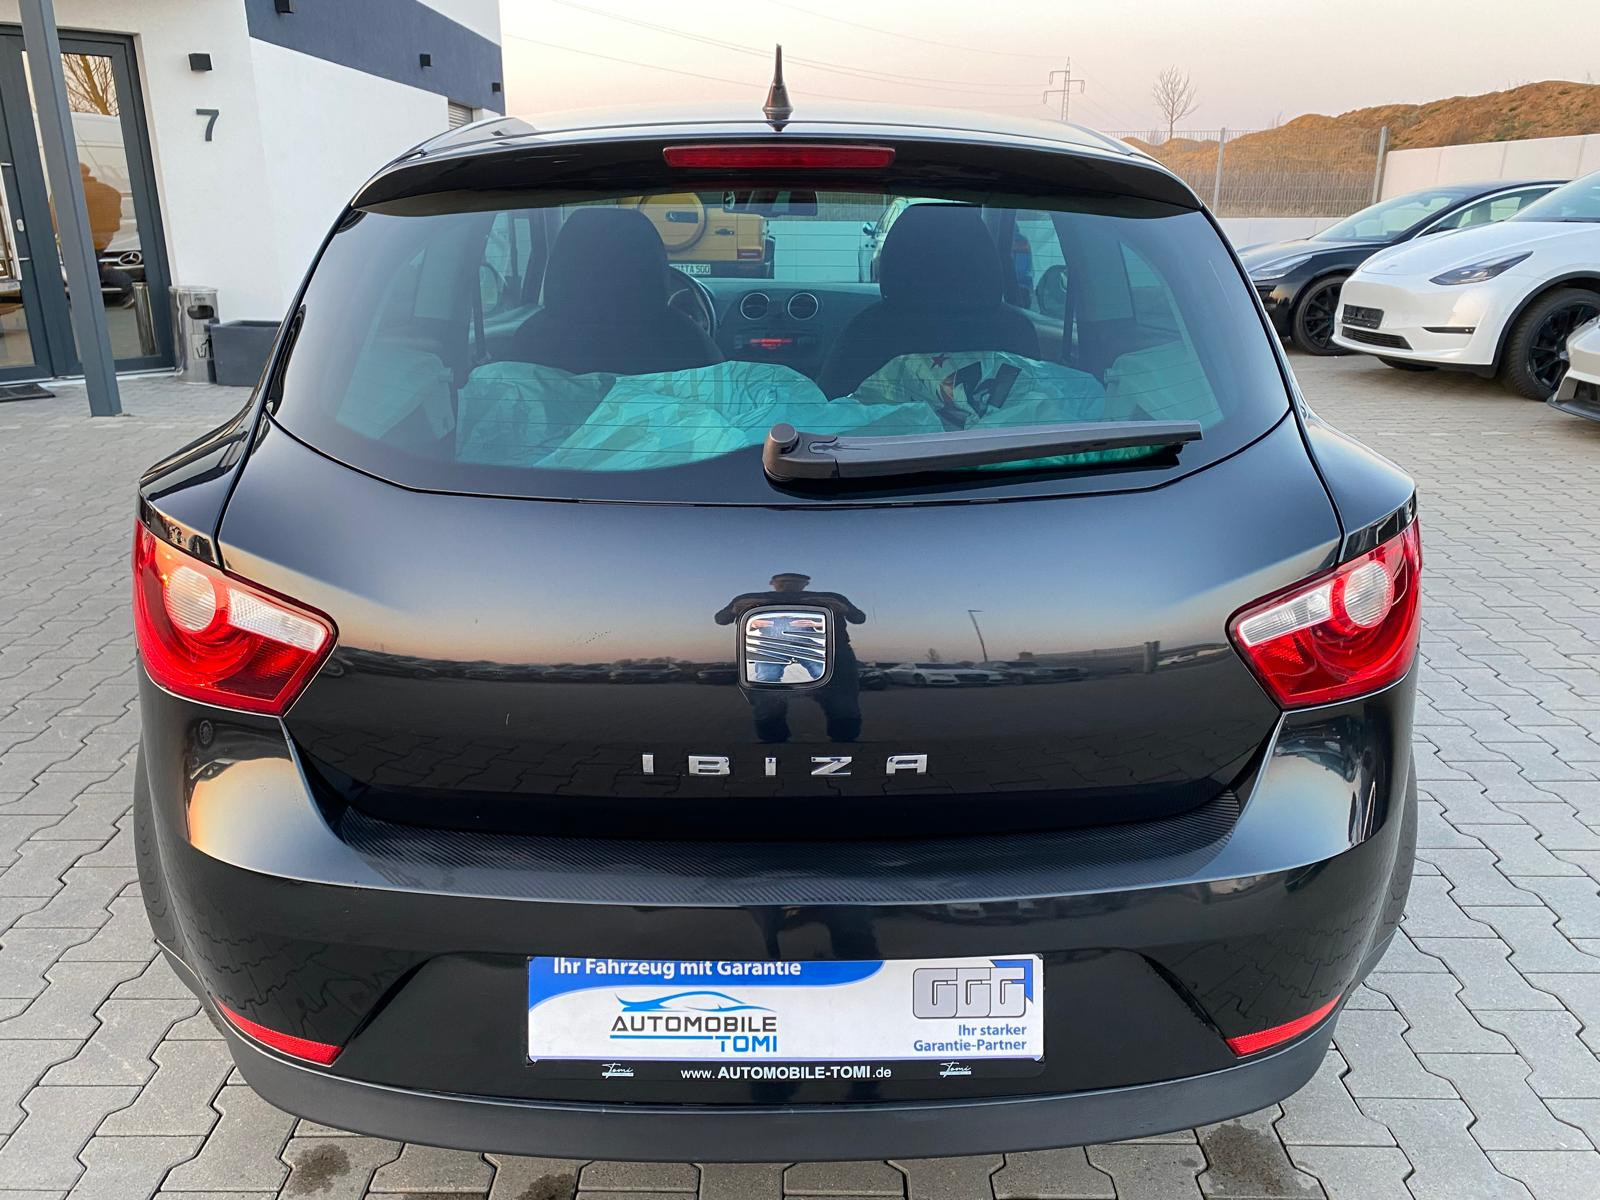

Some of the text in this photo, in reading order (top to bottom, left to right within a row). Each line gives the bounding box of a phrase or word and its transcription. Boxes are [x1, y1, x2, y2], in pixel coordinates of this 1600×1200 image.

[196, 109, 220, 142] 7
[641, 753, 928, 776] IBIZA
[554, 957, 801, 979] Ihr Fahrzeug mit Garantie
[611, 1016, 777, 1032] AUTOMOBILE
[958, 1023, 1027, 1036] Ihr starker
[715, 1035, 777, 1053] TOMI
[913, 1039, 1026, 1052] Garantie-Partner
